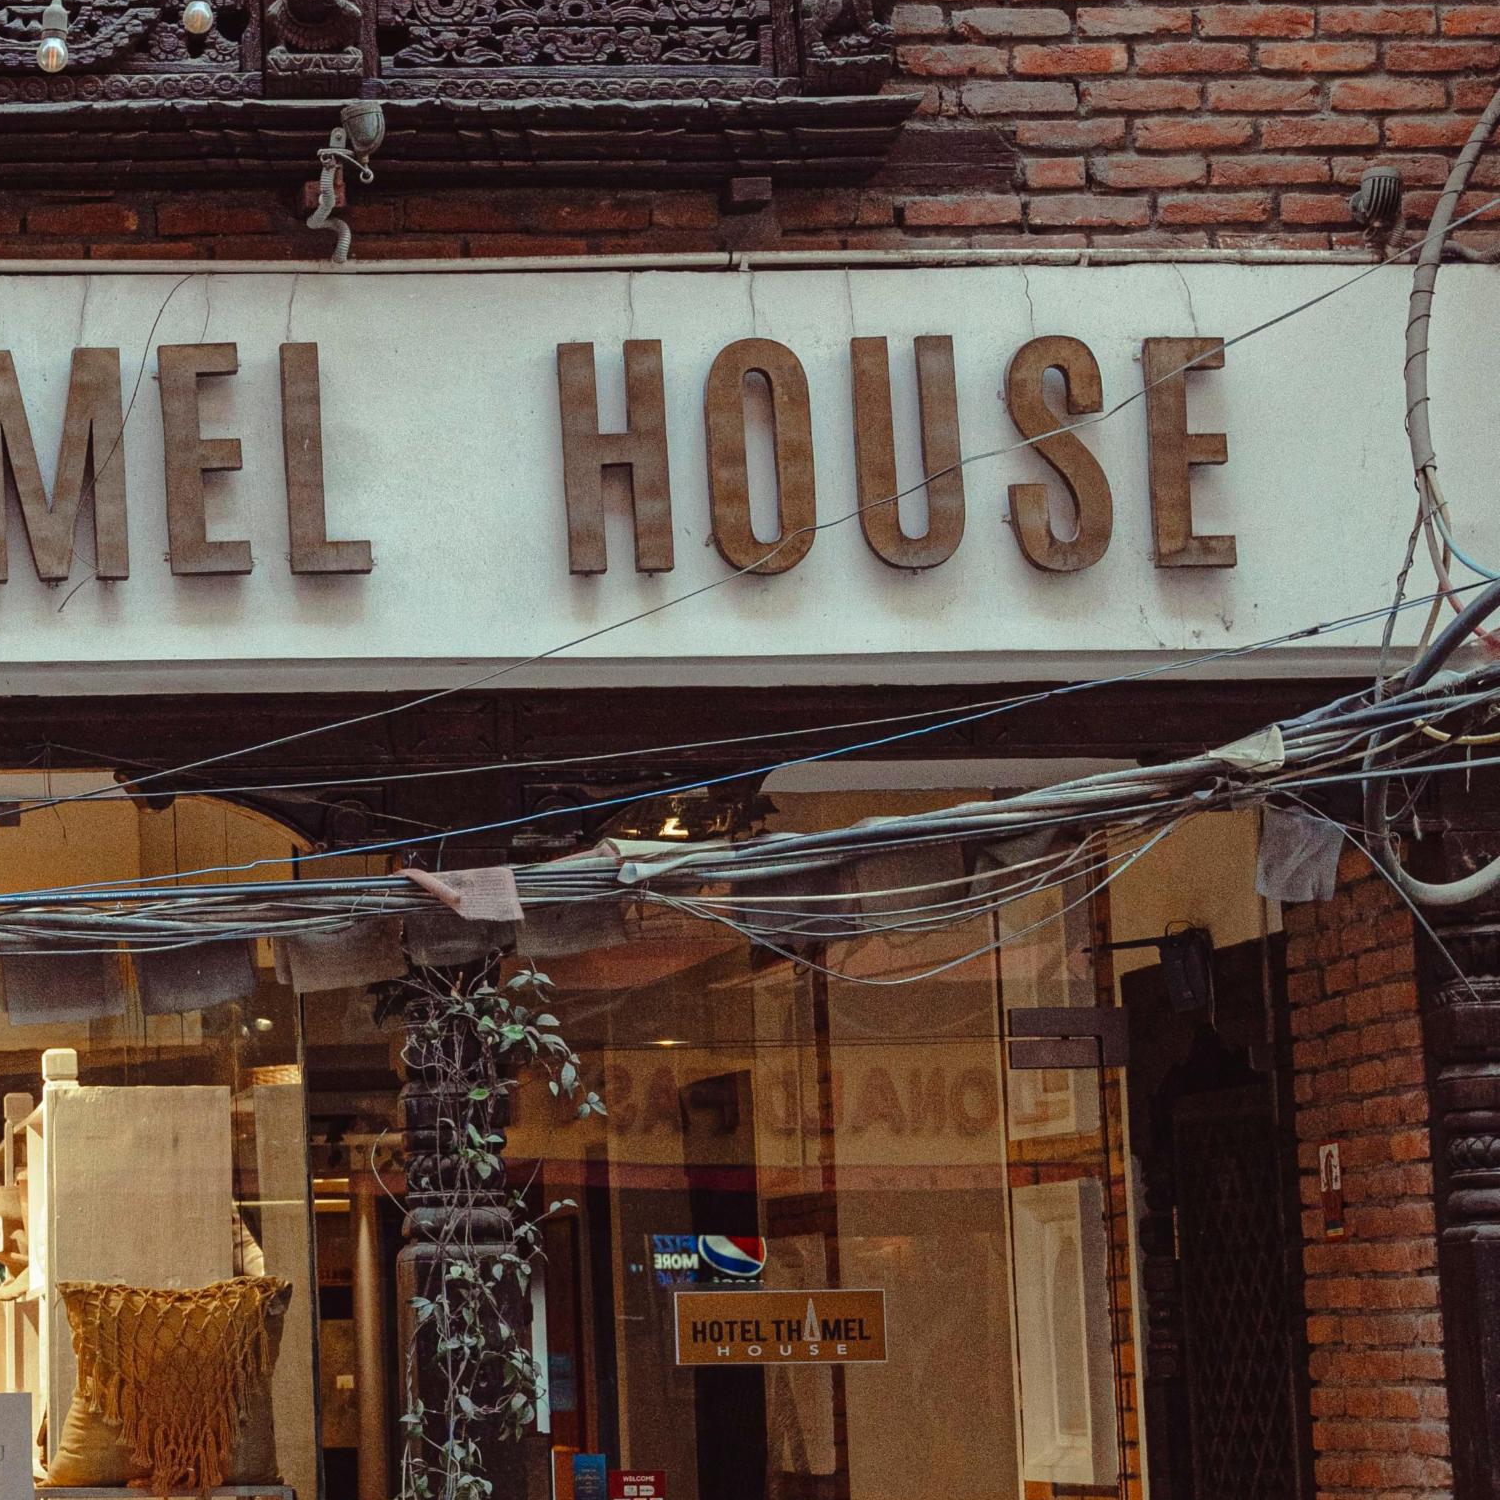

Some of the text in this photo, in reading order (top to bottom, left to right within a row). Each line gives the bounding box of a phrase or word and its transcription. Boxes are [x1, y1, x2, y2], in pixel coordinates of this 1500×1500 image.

[557, 334, 1238, 575] HOUSE
[691, 1297, 871, 1343] HOTEL THAMEL
[717, 1343, 848, 1357] HOUSE
